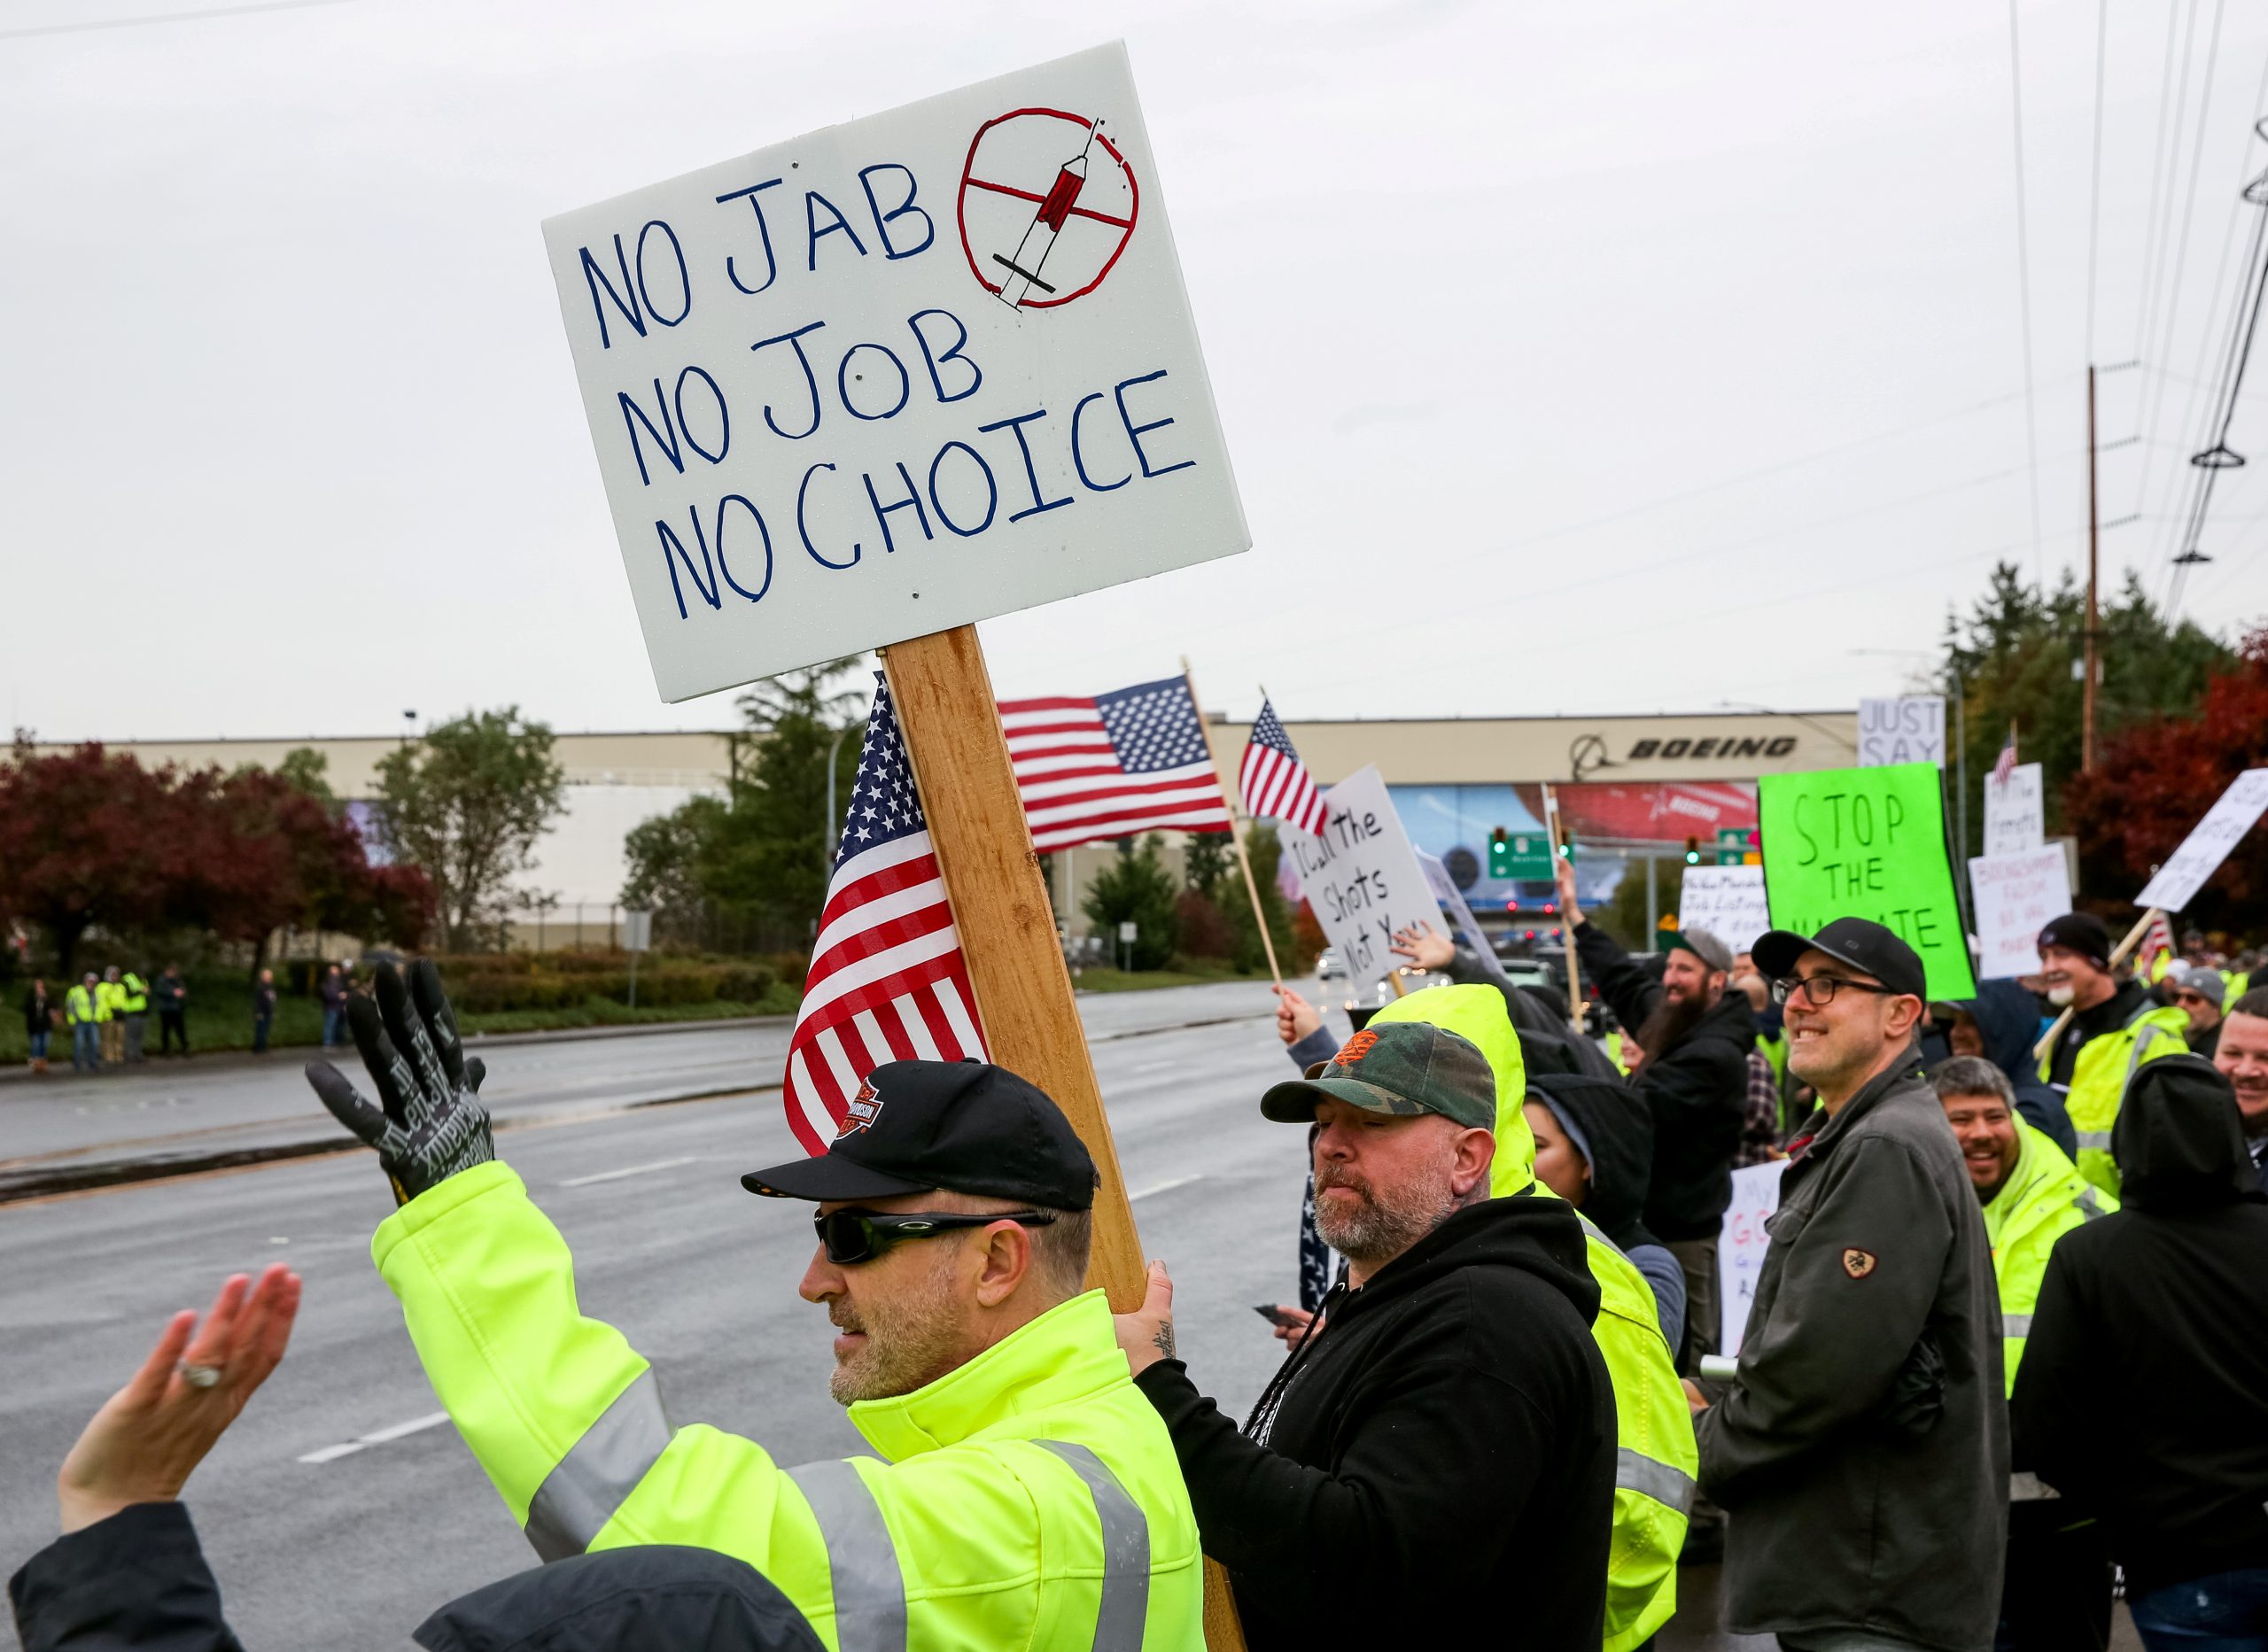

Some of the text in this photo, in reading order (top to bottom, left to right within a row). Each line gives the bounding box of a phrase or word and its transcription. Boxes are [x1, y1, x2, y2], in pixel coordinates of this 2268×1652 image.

[580, 164, 935, 348] NO JAB
[618, 310, 982, 485] NO JOB
[656, 370, 1196, 619] NO CHOICE
[1862, 702, 1943, 734] JUST
[1628, 737, 1798, 760] BOEING
[1864, 737, 1940, 768] SAY
[1332, 806, 1383, 849] The
[1793, 793, 1905, 866] STOP
[1822, 856, 1884, 900] THE
